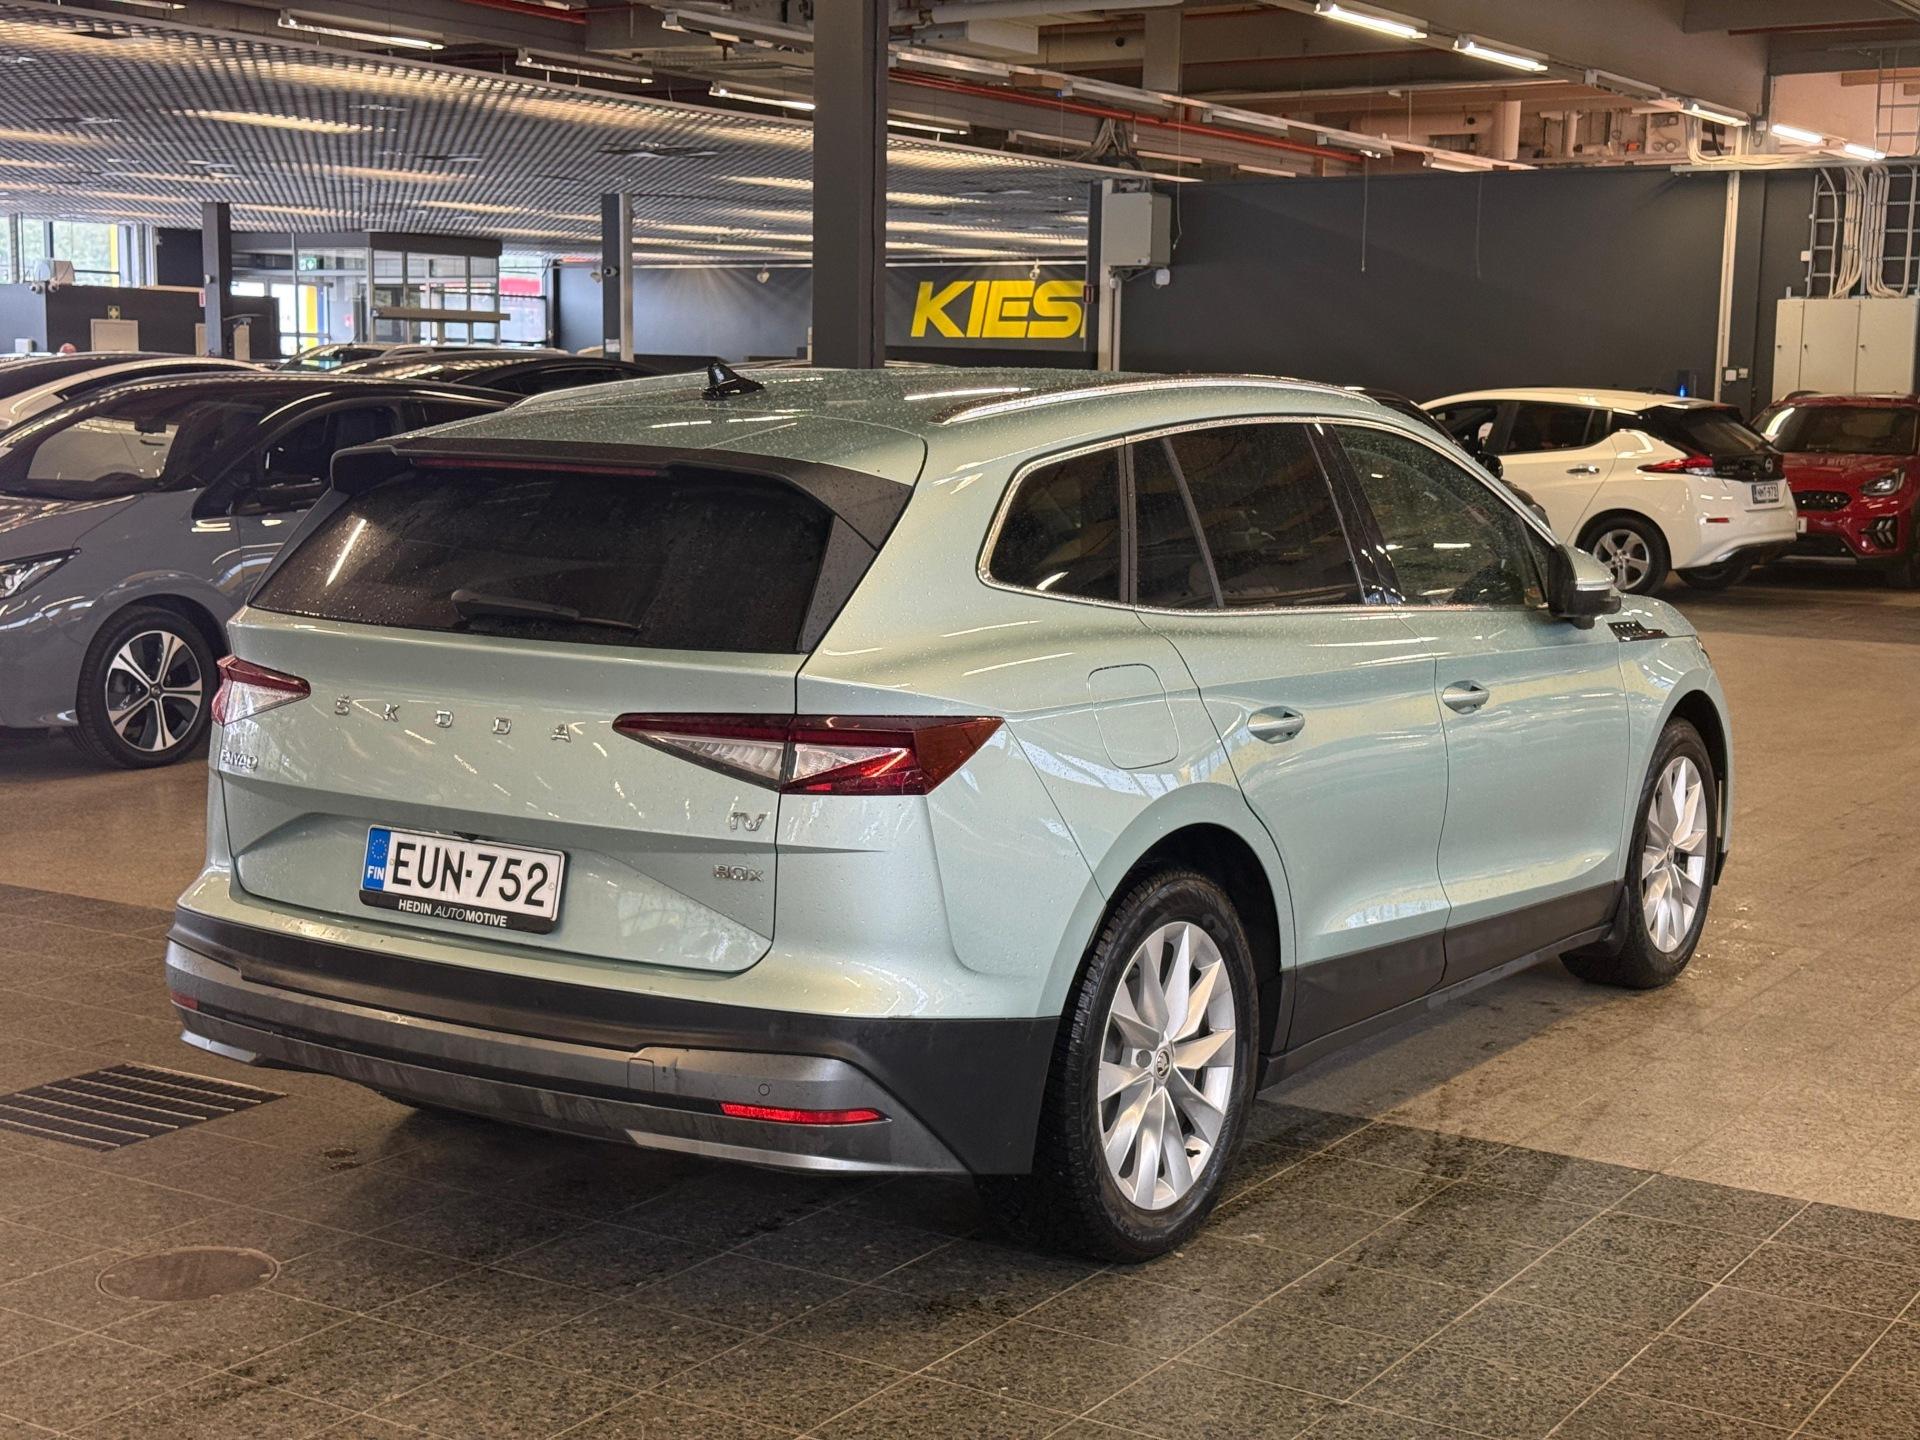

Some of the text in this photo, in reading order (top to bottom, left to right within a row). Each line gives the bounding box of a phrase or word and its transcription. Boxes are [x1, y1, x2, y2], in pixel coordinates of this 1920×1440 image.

[910, 280, 1086, 338] KIES
[367, 865, 385, 881] FIN
[392, 841, 549, 908] EUN-752
[398, 898, 508, 927] HEDIN AUTOMOTIVE
